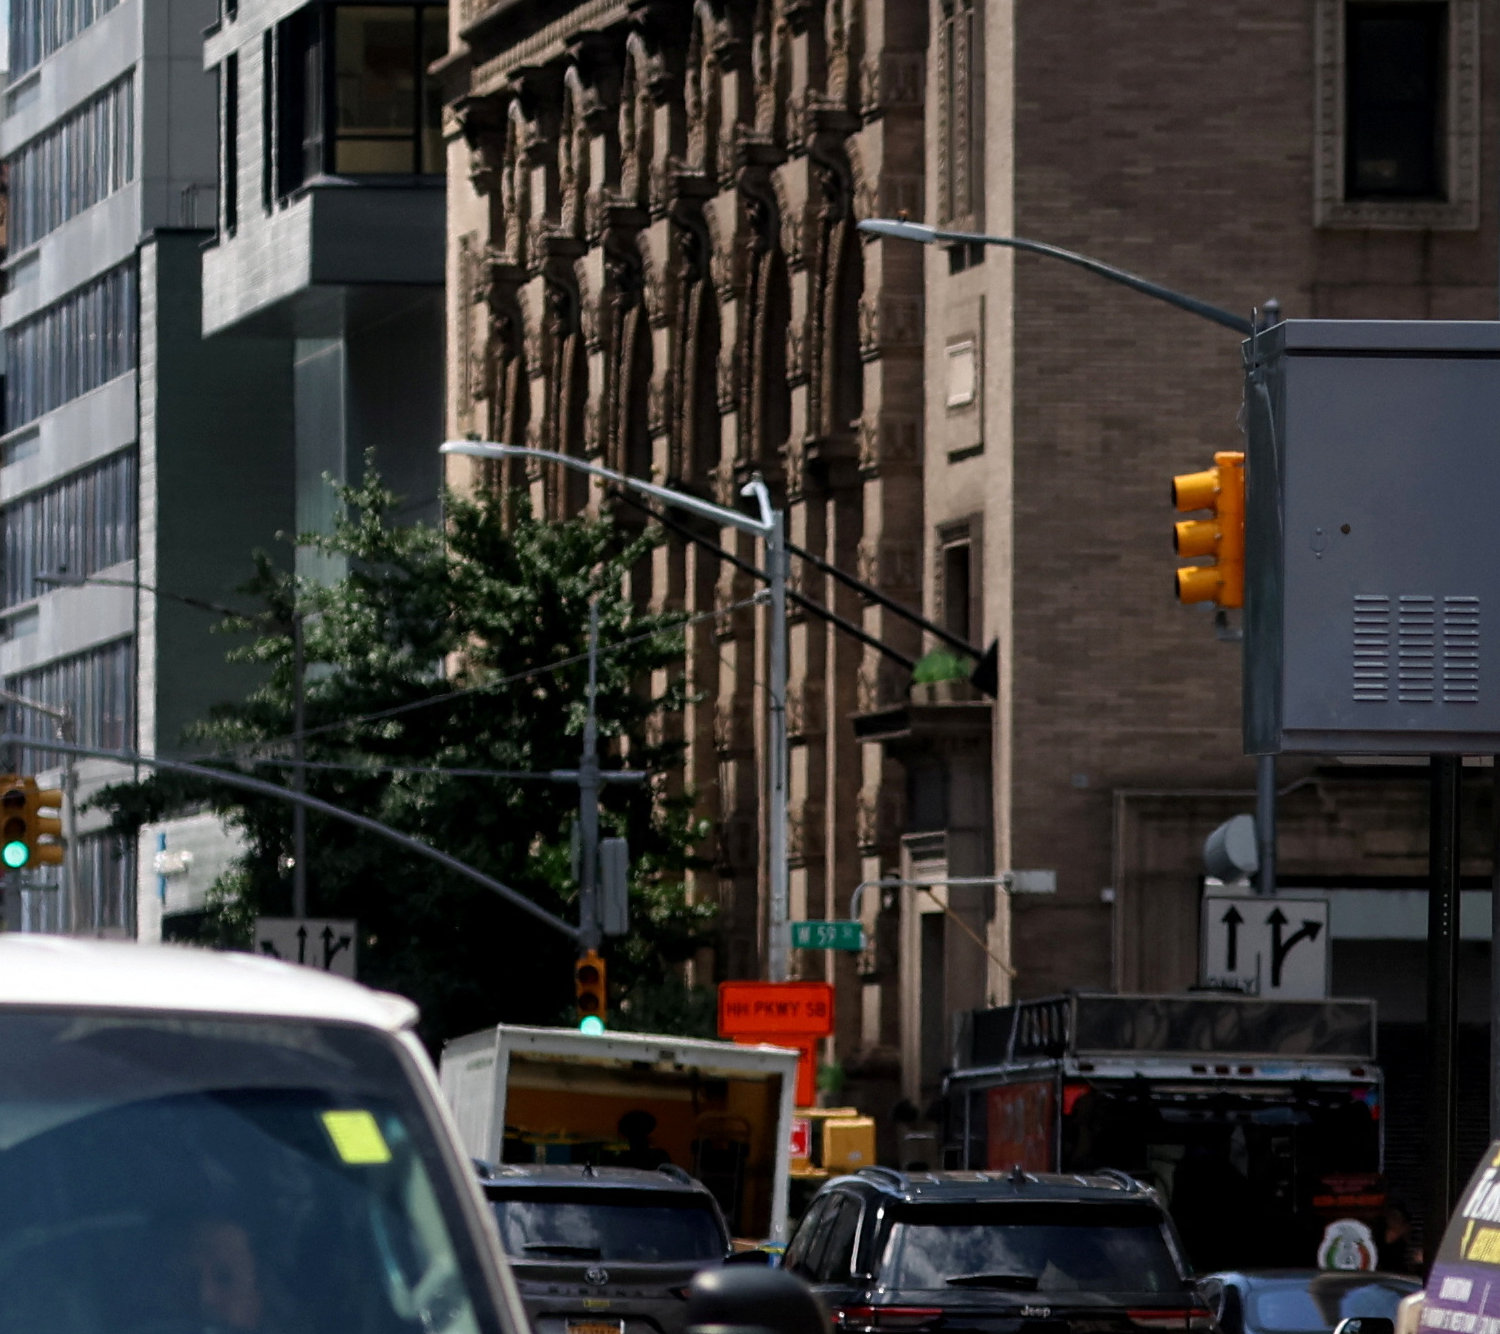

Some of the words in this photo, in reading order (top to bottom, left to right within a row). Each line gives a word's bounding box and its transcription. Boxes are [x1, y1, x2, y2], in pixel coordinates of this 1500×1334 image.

[797, 926, 811, 945] W
[817, 926, 837, 946] 59
[1020, 1304, 1051, 1317] Jeep
